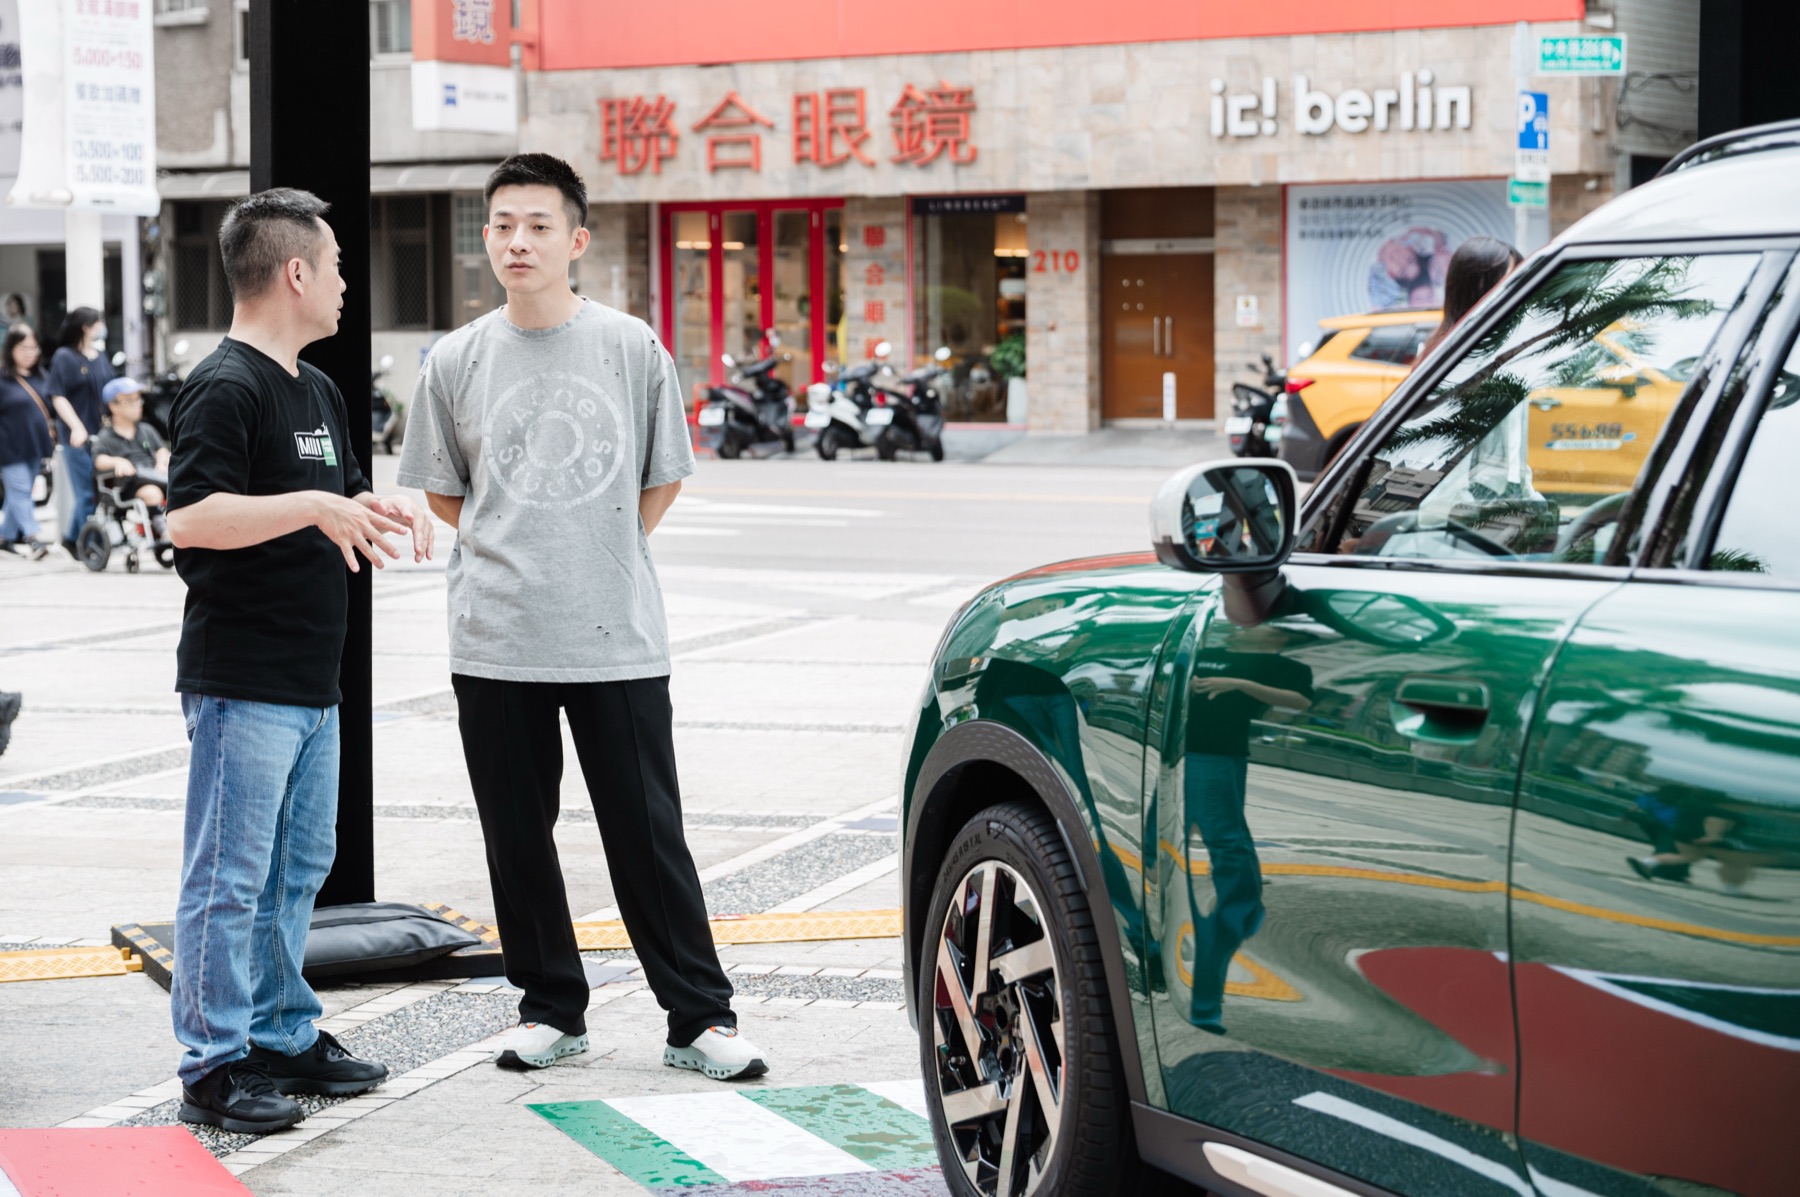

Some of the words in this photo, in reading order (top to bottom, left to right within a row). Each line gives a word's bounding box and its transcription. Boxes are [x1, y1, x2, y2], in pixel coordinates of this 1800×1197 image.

[1209, 77, 1278, 137] ic!
[1294, 68, 1472, 135] berlin
[1518, 93, 1537, 133] P
[598, 80, 978, 175] 聯合眼鏡
[1033, 249, 1080, 273] 210
[511, 387, 597, 427] Acne
[498, 439, 612, 497] Studios
